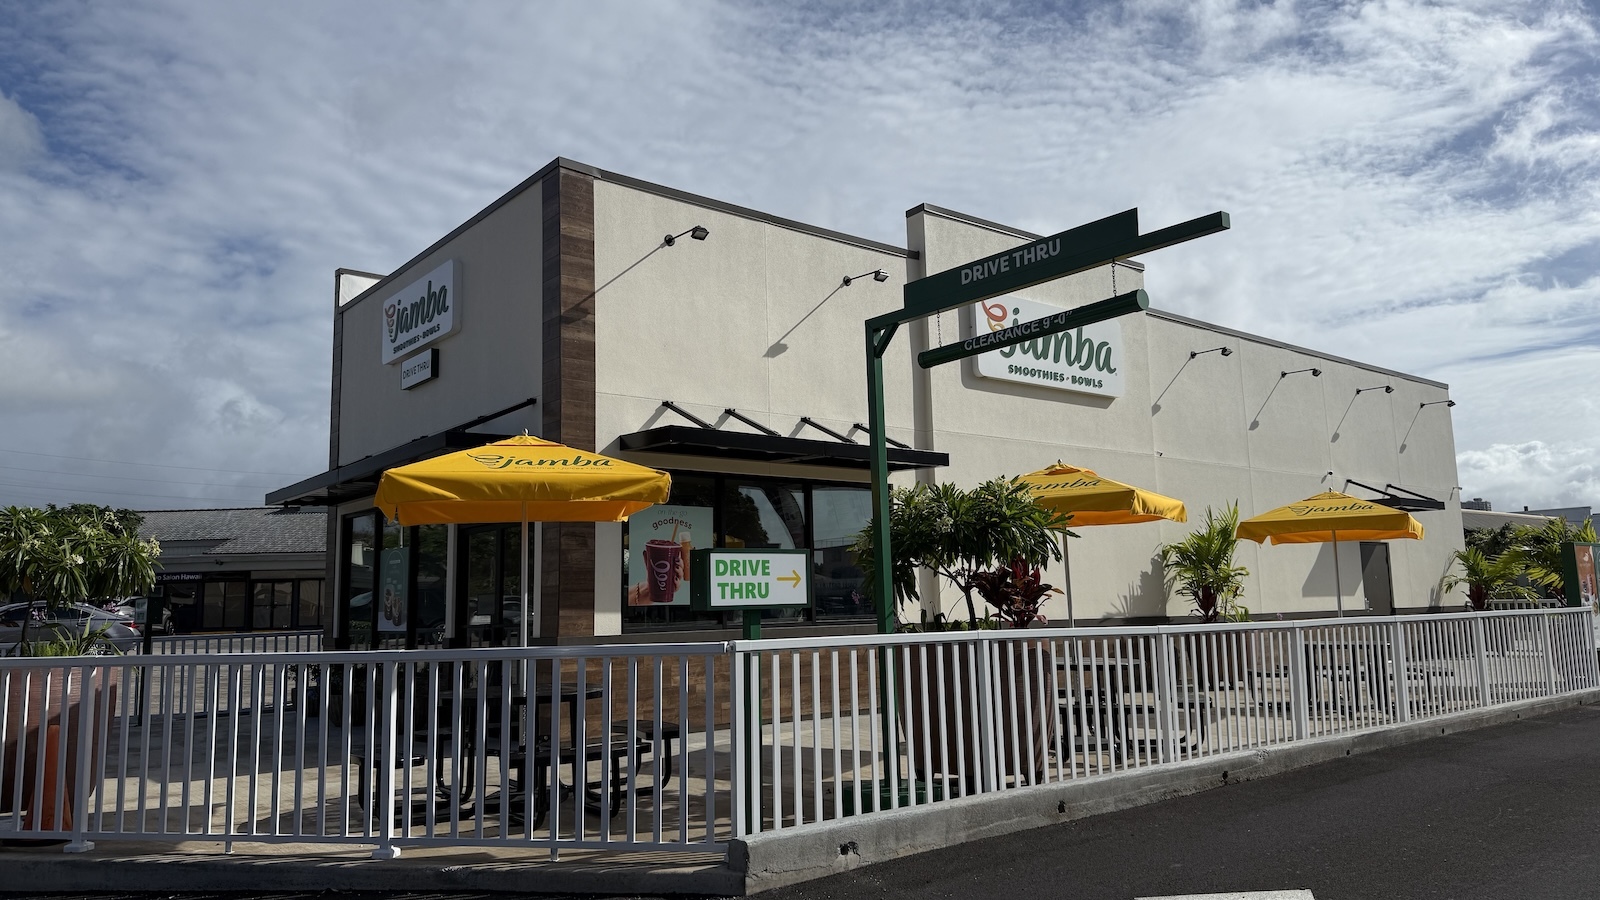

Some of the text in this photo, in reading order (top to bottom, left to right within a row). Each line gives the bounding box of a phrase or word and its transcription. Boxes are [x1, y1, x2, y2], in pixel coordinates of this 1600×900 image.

[961, 238, 1061, 285] DRIVE THRU
[390, 280, 449, 343] jamba
[393, 323, 441, 354] SMOOTHIES BOWLS
[964, 320, 1040, 351] CLEARANCE
[402, 360, 430, 380] DRIVE THRU
[1007, 364, 1103, 389] SMOOTHIES BOWLS
[488, 455, 614, 469] jamba
[1296, 503, 1375, 516] jamba
[652, 516, 693, 531] goodness
[715, 559, 771, 577] DRIVE
[717, 582, 770, 600] THRU
